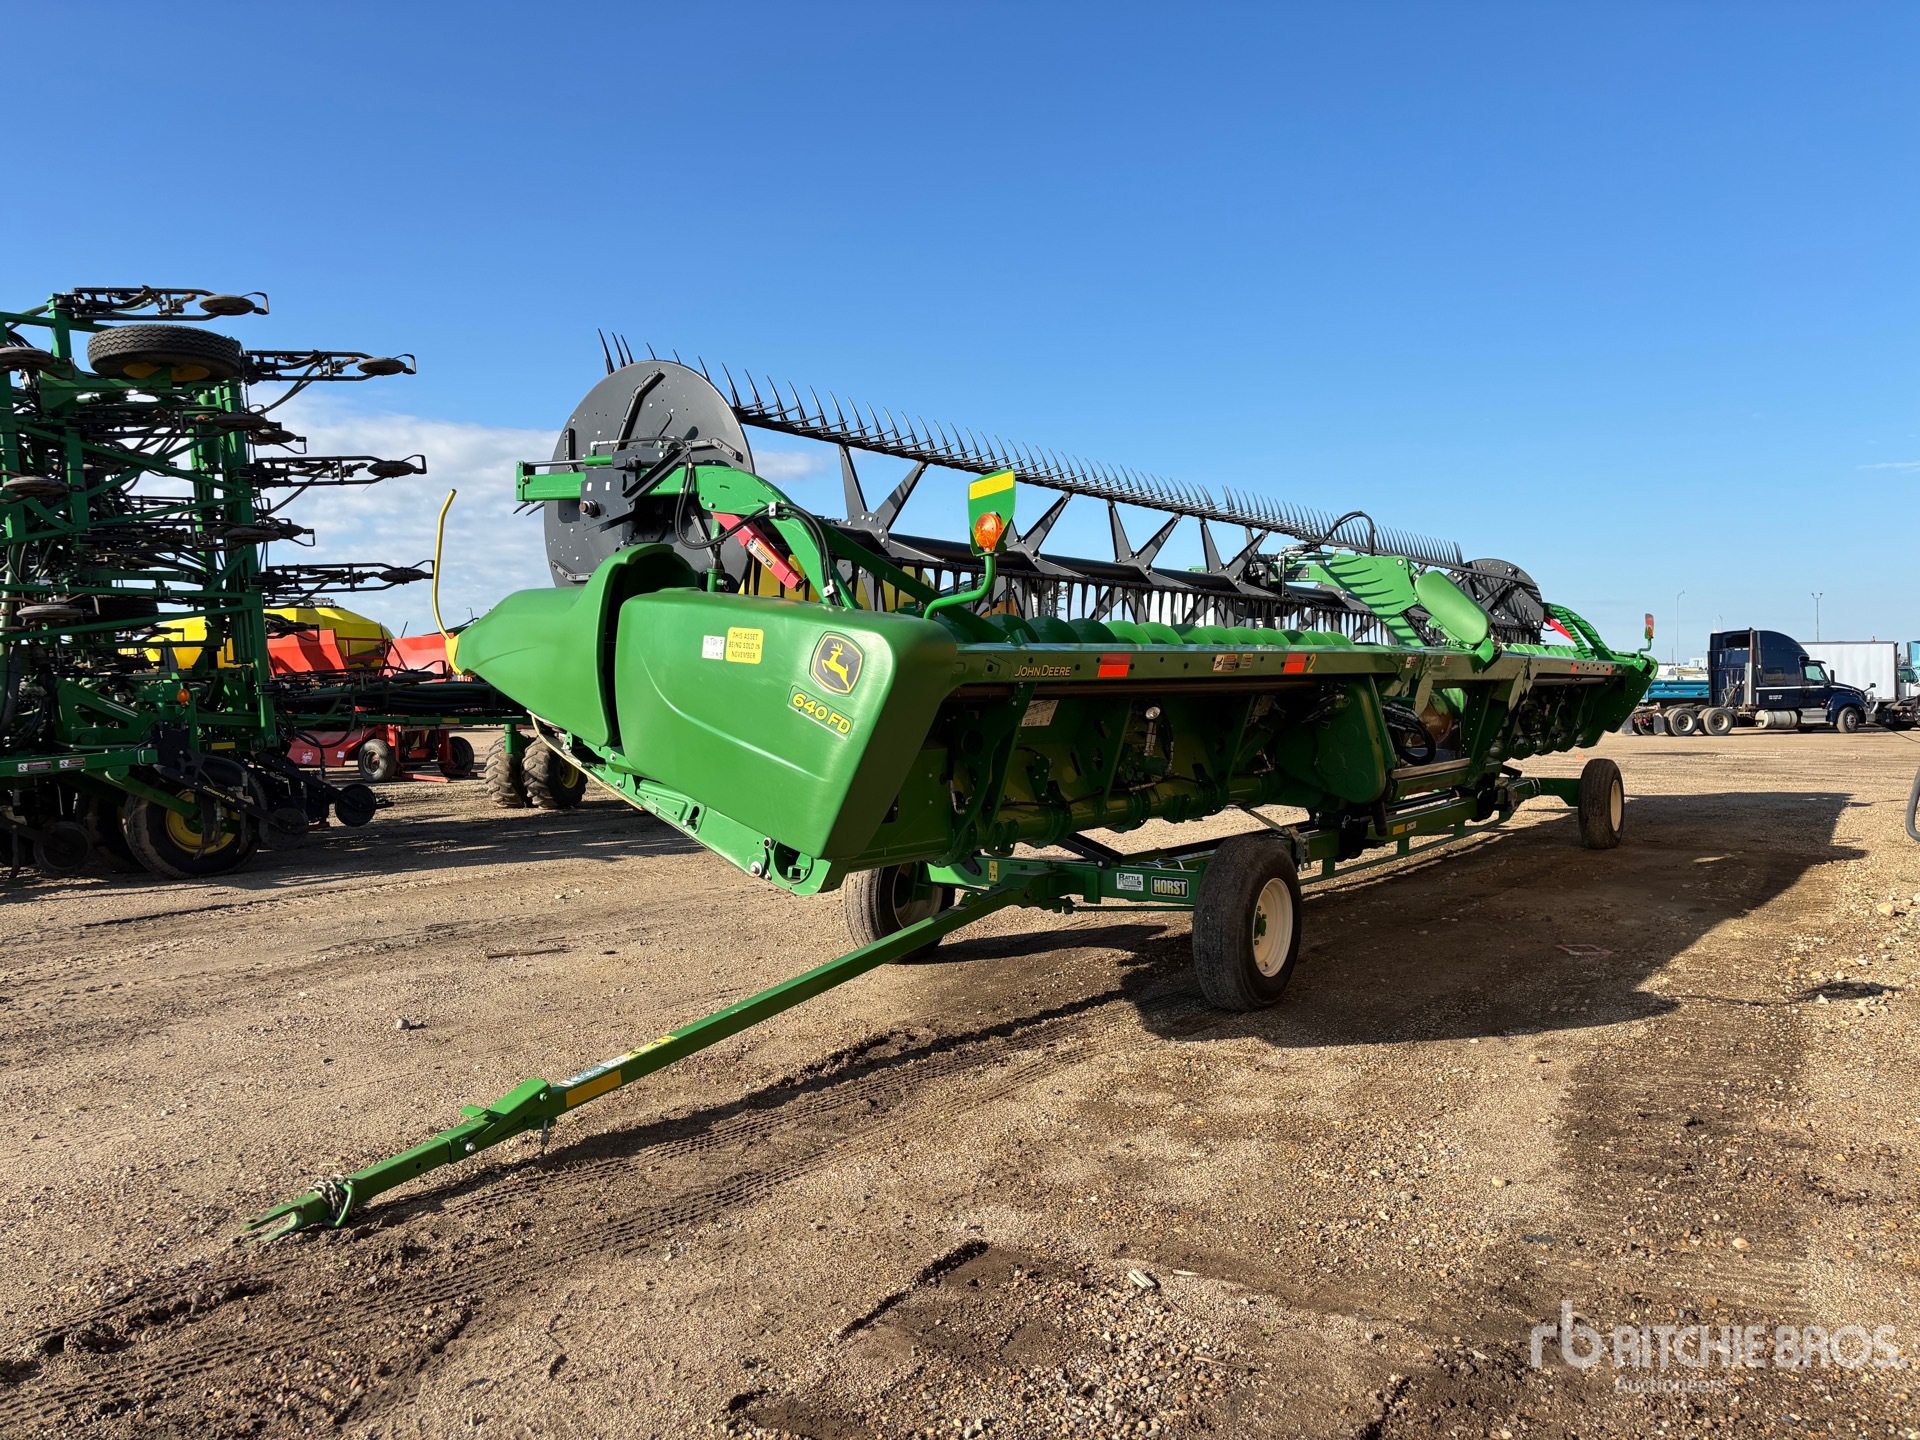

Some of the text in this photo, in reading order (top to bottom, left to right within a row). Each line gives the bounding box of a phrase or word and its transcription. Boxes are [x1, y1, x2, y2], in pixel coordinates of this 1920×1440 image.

[728, 641, 742, 649] BEING
[743, 642, 755, 650] SOLD
[731, 650, 756, 659] NOVEMBER
[1306, 653, 1317, 673] 2
[1014, 664, 1072, 678] JOHN DEERE
[792, 692, 852, 735] 640 FD
[1153, 879, 1187, 896] HORST
